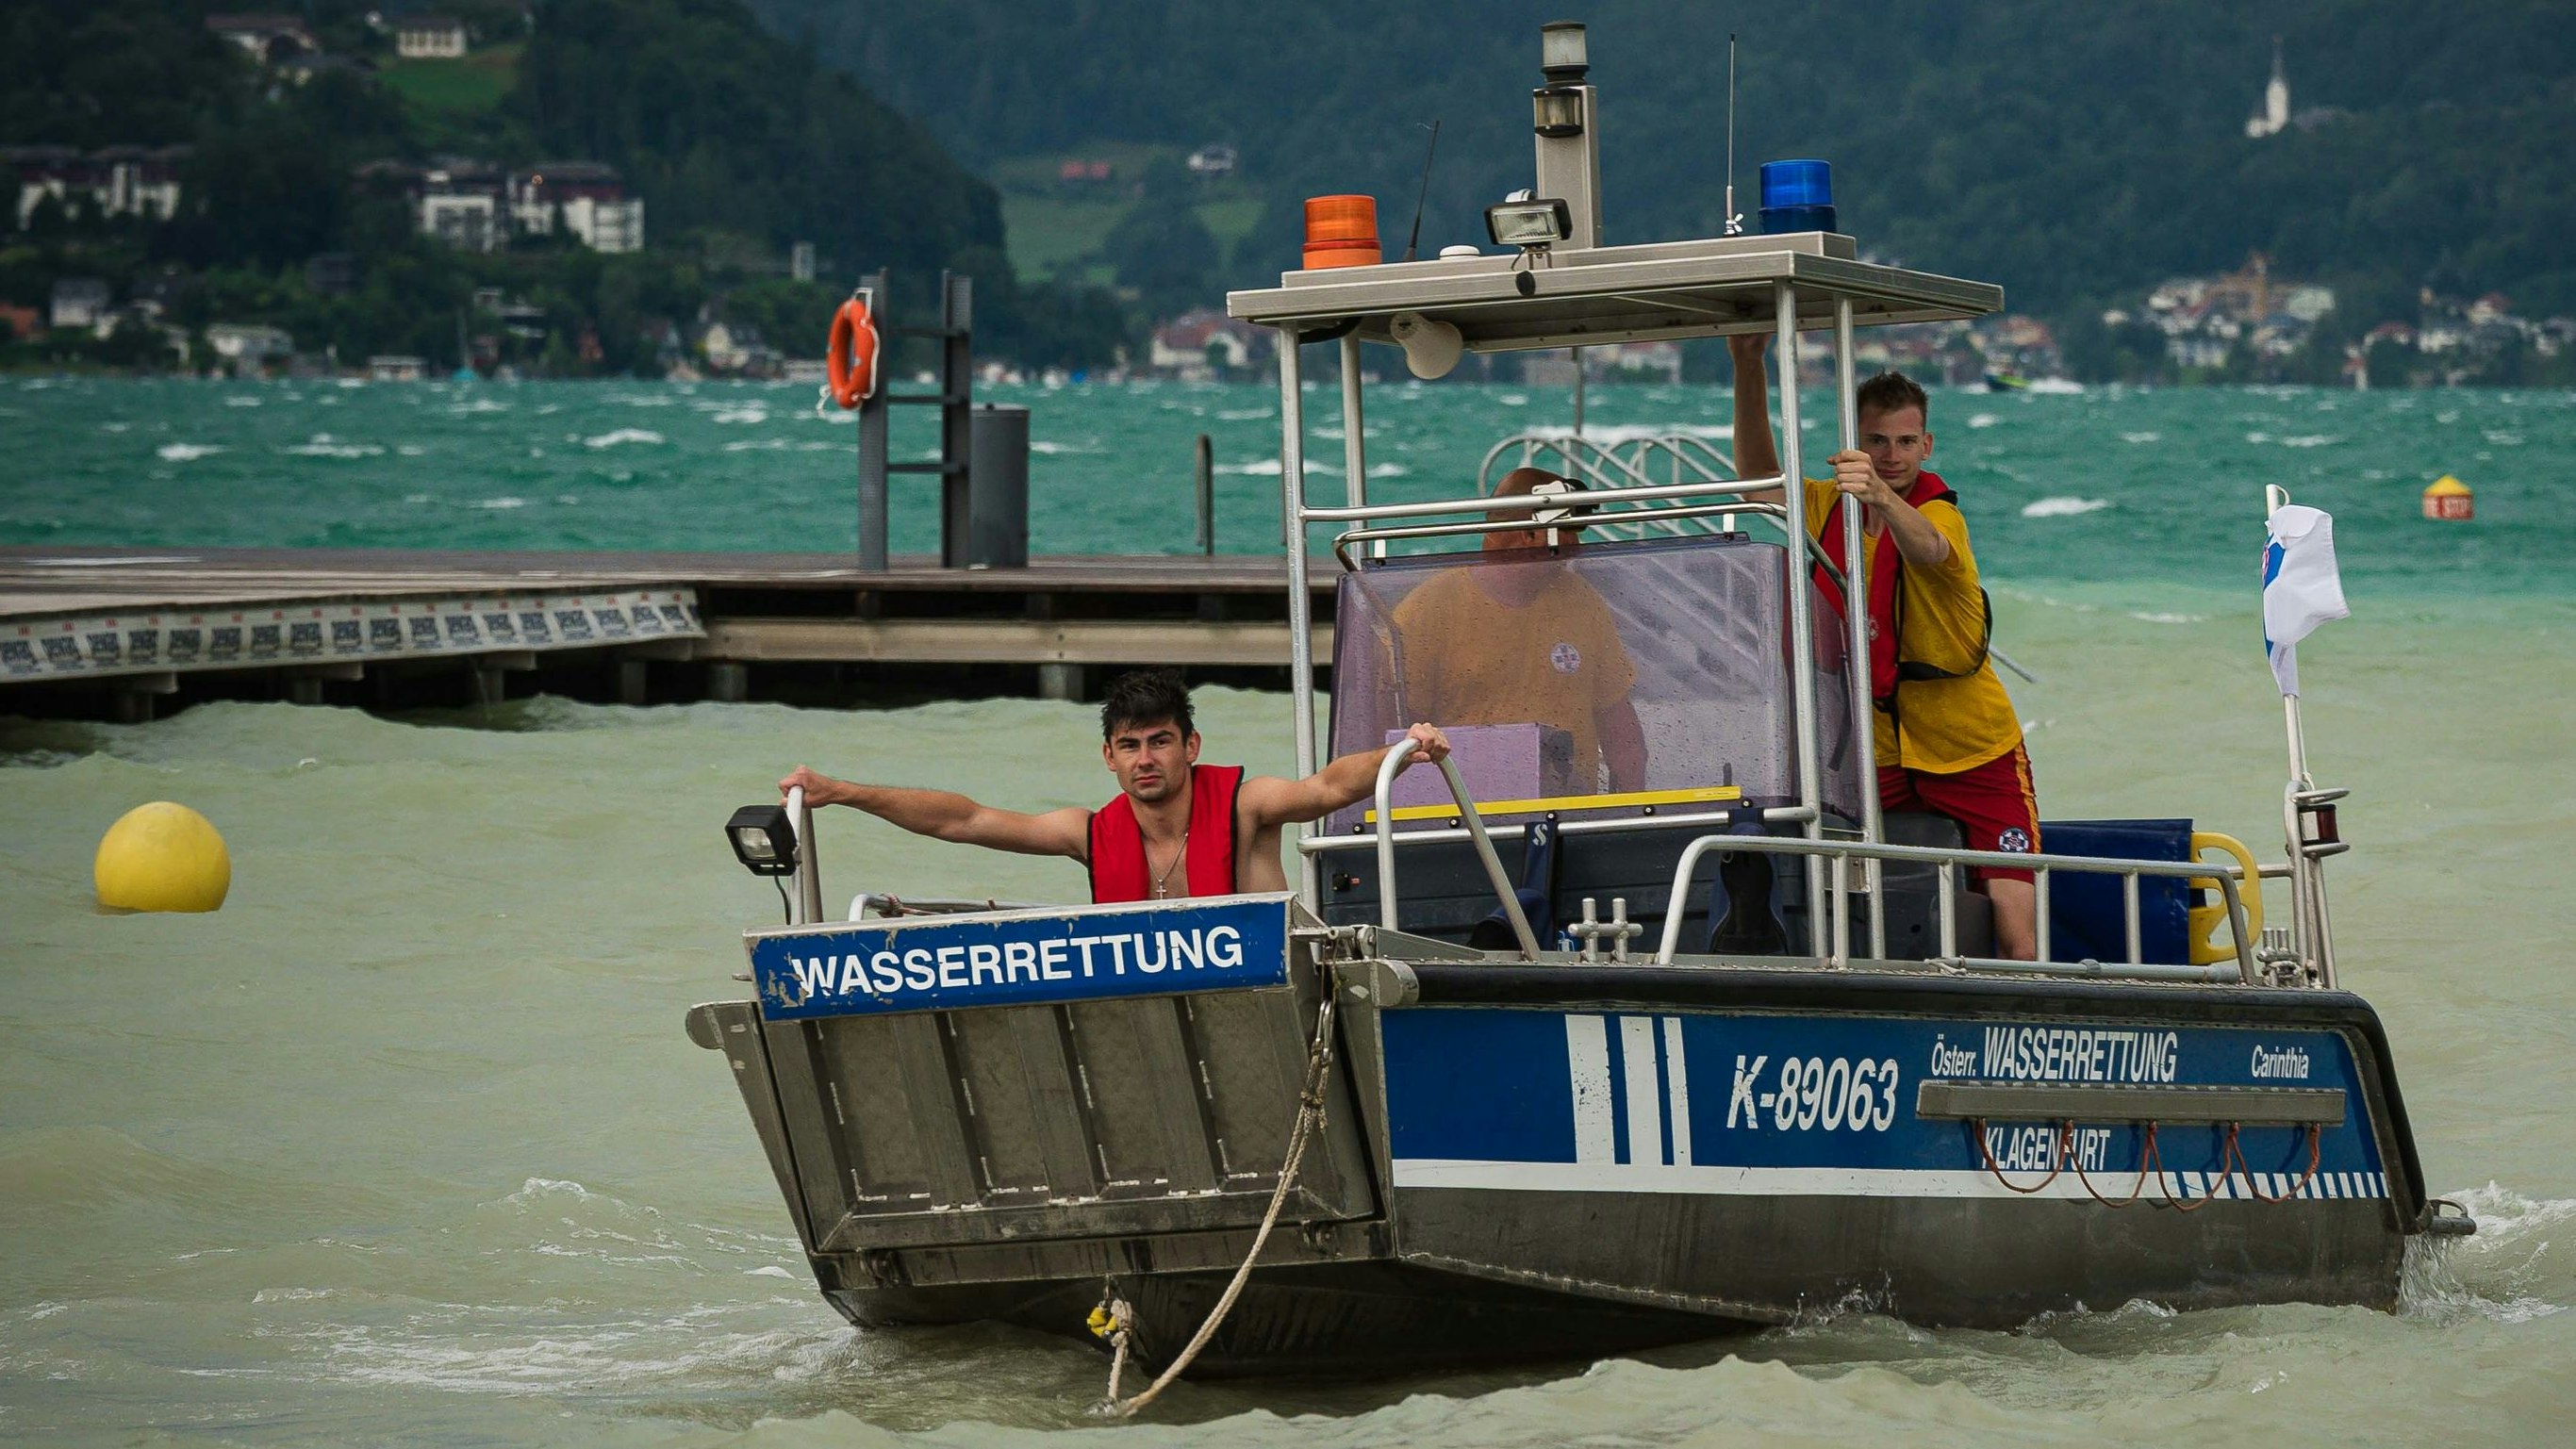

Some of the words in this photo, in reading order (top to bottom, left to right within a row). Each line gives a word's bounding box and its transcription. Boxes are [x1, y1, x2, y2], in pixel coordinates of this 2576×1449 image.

[791, 925, 1244, 998] WASSERRETTUNG
[1932, 1033, 1976, 1077] Österr.
[1983, 1027, 2178, 1082] WASSERRETTUNG
[2251, 1045, 2309, 1079] Carinthia
[1726, 1055, 1899, 1131] K-89063
